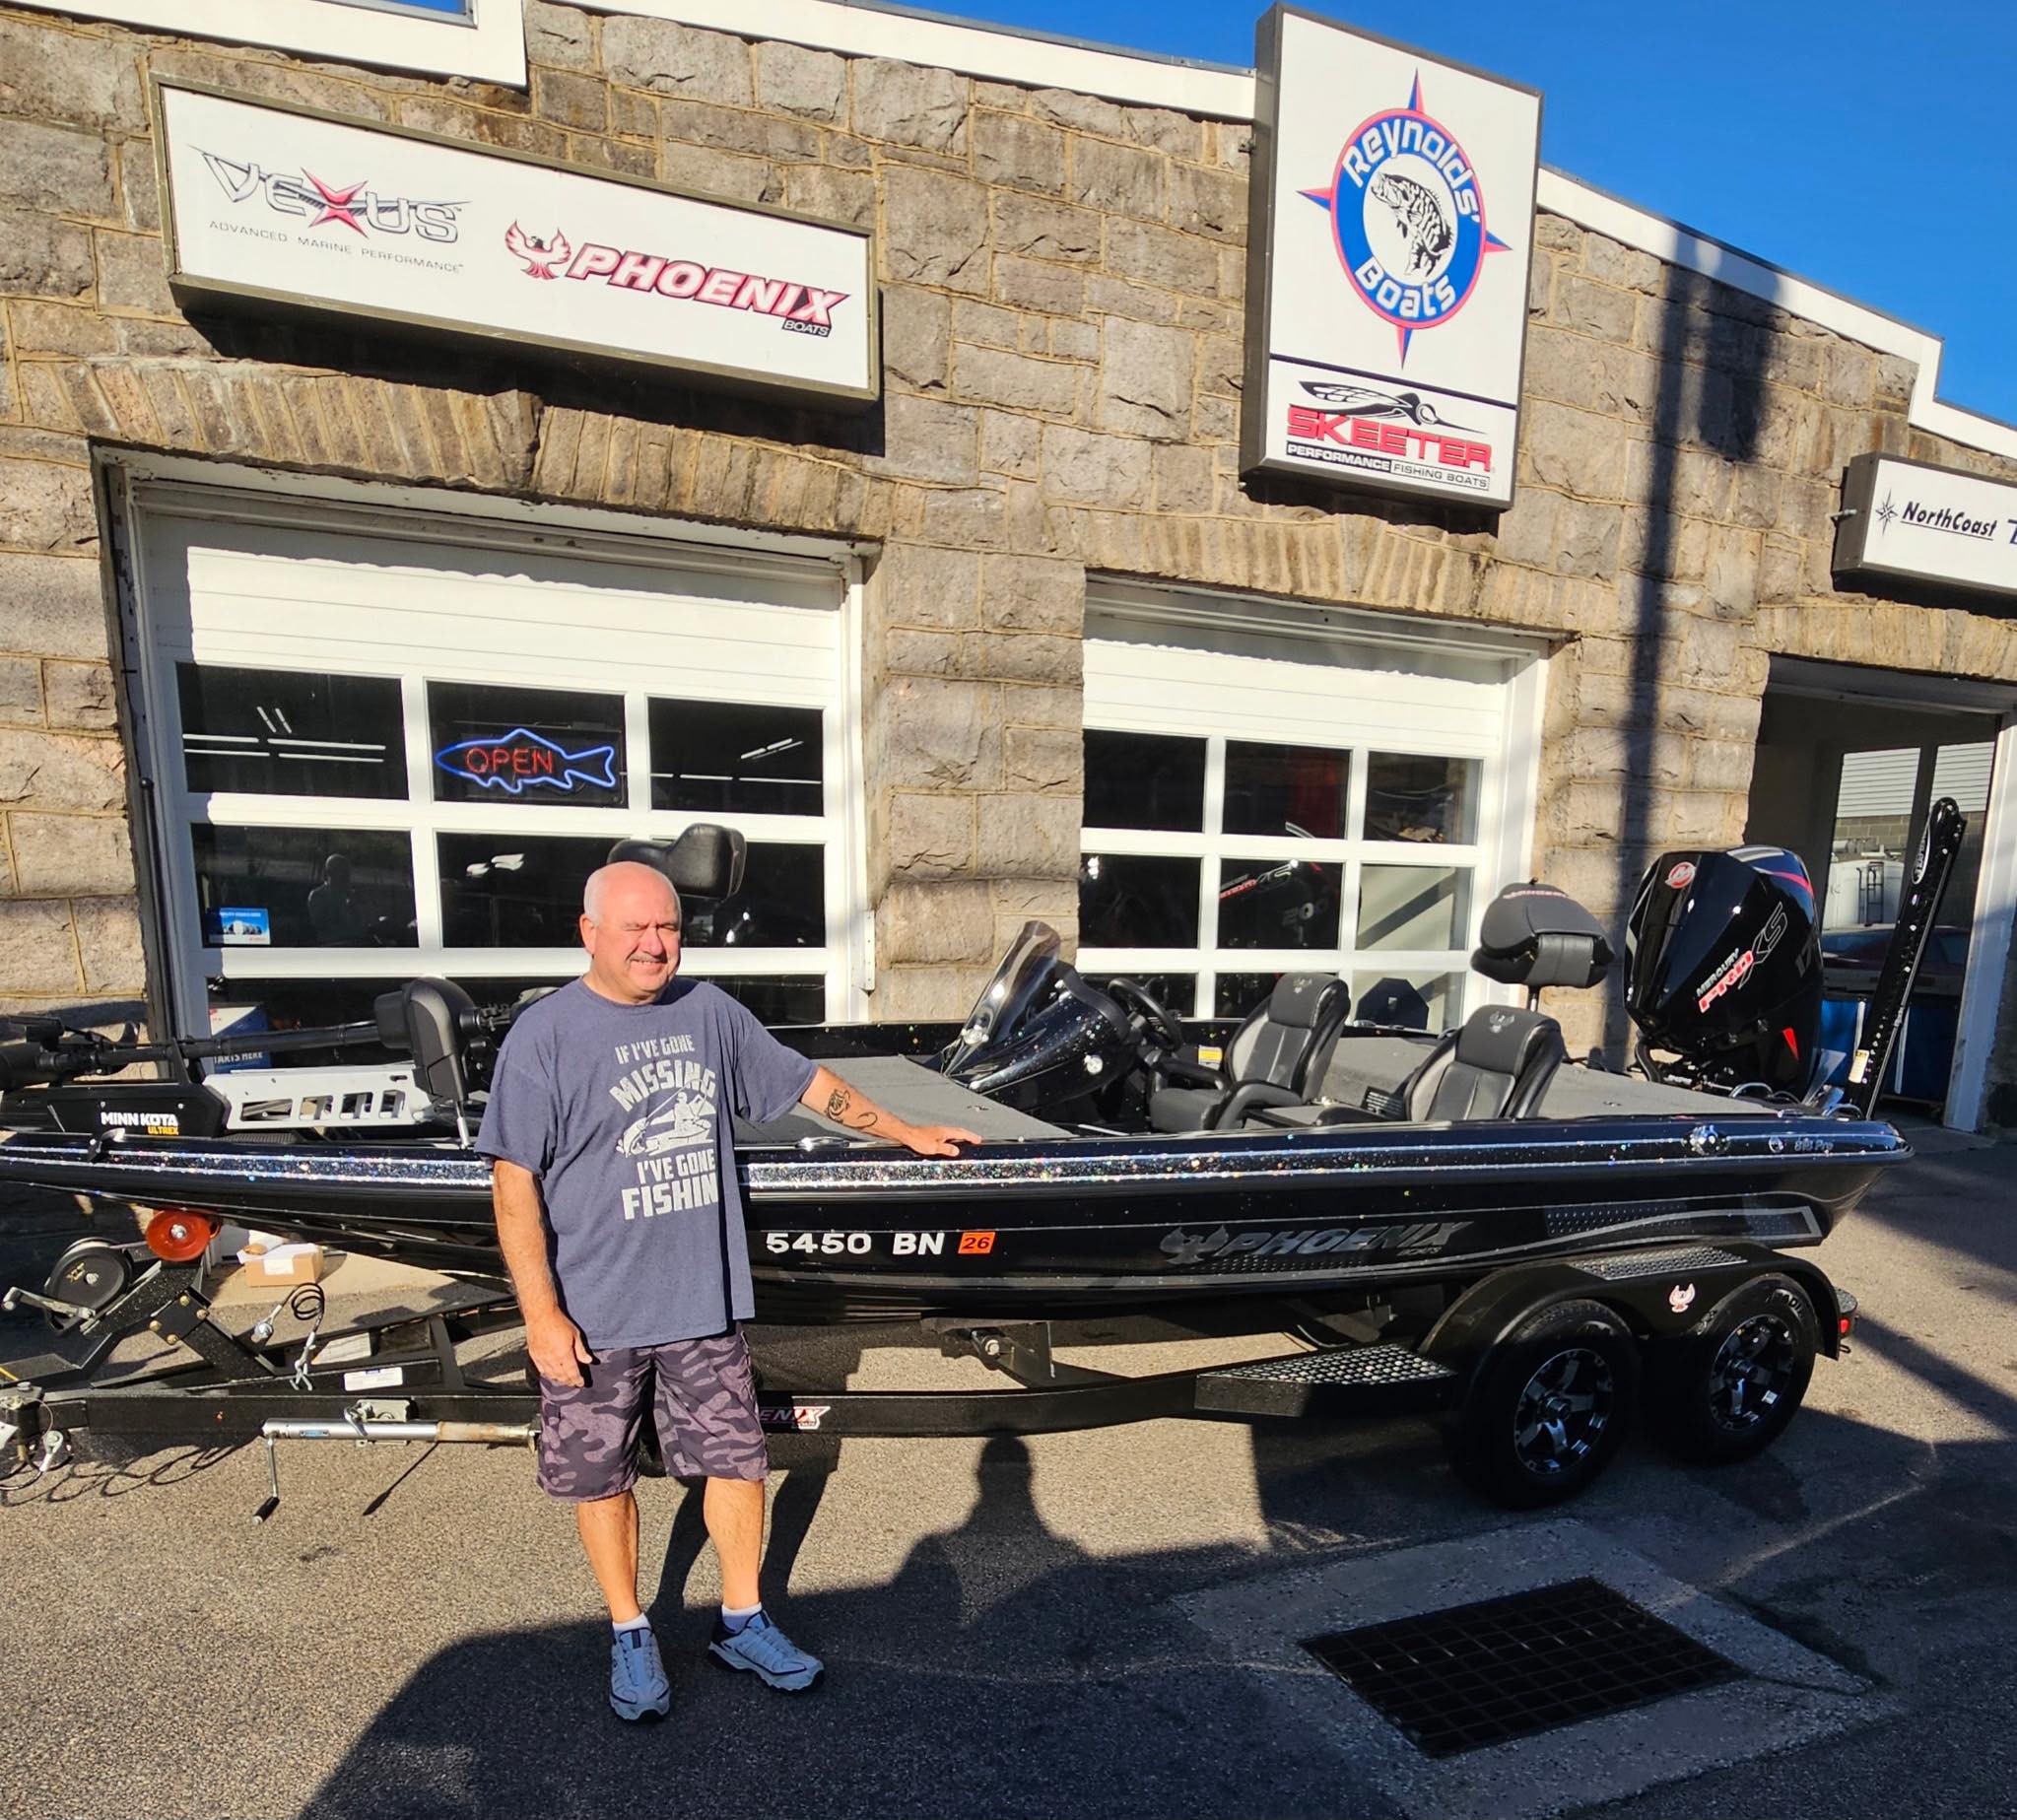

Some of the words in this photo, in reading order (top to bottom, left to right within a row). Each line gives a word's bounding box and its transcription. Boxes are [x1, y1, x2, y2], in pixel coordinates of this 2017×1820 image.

[209, 220, 288, 242] ADVANCED
[298, 236, 352, 254] MARINE
[361, 248, 461, 274] PERFORMANCE
[565, 242, 850, 326] PHOENIX
[1355, 256, 1456, 318] Boats
[784, 319, 830, 337] BOATS
[1287, 406, 1492, 473] SKEETER
[1288, 443, 1390, 471] PERFORMANCE
[1393, 463, 1443, 480] FISHING
[1446, 474, 1488, 488] BOATS
[1902, 501, 1997, 537] NorthCoast
[466, 747, 553, 775] OPEN
[1696, 947, 1739, 997] MERCURY
[615, 1045, 630, 1064] IF
[632, 1040, 659, 1061] I'VE
[660, 1035, 695, 1056] GONE
[609, 1059, 716, 1112] MISSING
[101, 1112, 139, 1126] MINN
[140, 1112, 178, 1126] KOTA
[148, 1126, 179, 1136] ULTREX
[638, 1157, 673, 1183] I'VE
[676, 1149, 716, 1177] GONE
[766, 1232, 872, 1254] 5450
[892, 1232, 945, 1254] BN
[961, 1237, 991, 1250] 26
[1213, 1221, 1475, 1257] PHOENIX
